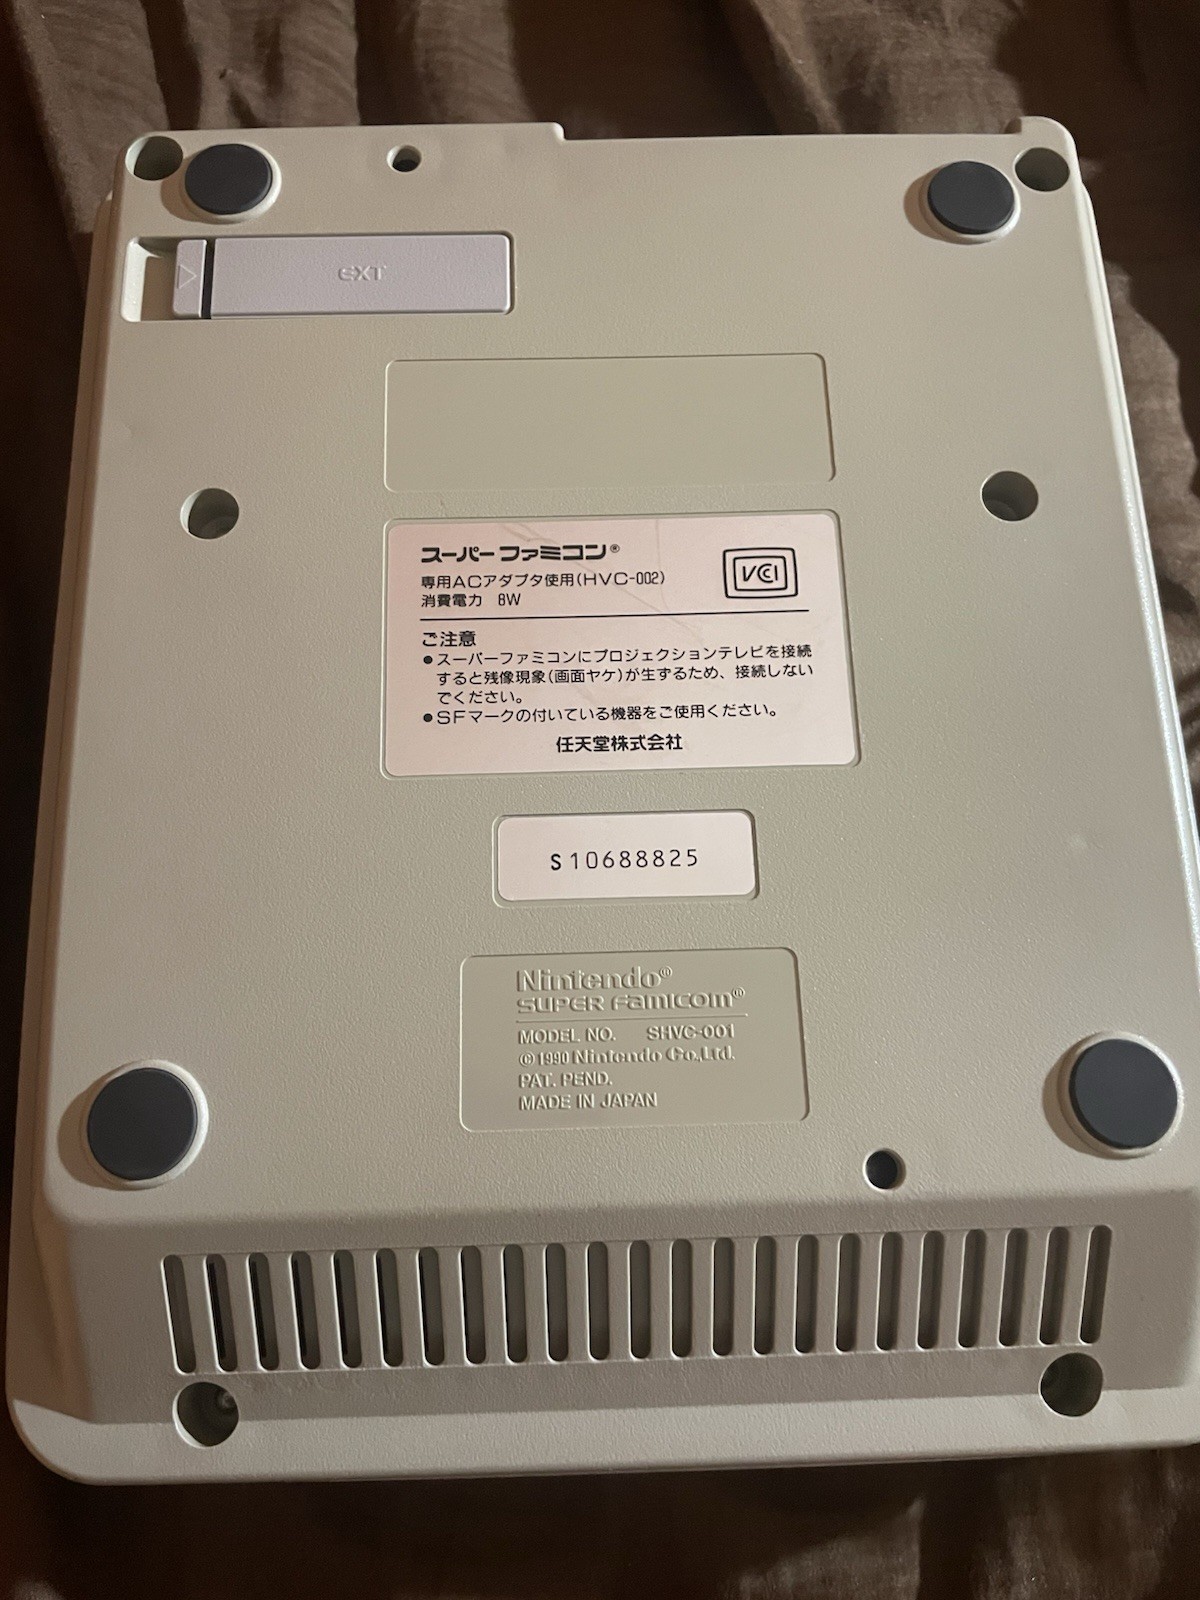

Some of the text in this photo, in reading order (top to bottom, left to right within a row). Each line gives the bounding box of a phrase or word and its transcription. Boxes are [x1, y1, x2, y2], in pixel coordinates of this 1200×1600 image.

[421, 546, 495, 563] スーパー
[420, 593, 521, 608] 消費電力 8W
[422, 630, 477, 648] ご注意
[437, 690, 523, 705] でください。
[555, 733, 684, 753] 任天堂株式会社
[550, 848, 699, 871] S10688825
[516, 994, 605, 1014] SUPER
[518, 1023, 735, 1044] MODEL NO. SHVC-001
[538, 1050, 570, 1066] 1990
[571, 1047, 663, 1064] Nintendo
[519, 1070, 613, 1088] PAT. PEND.
[519, 1091, 658, 1110] MADE IN JAPAN
